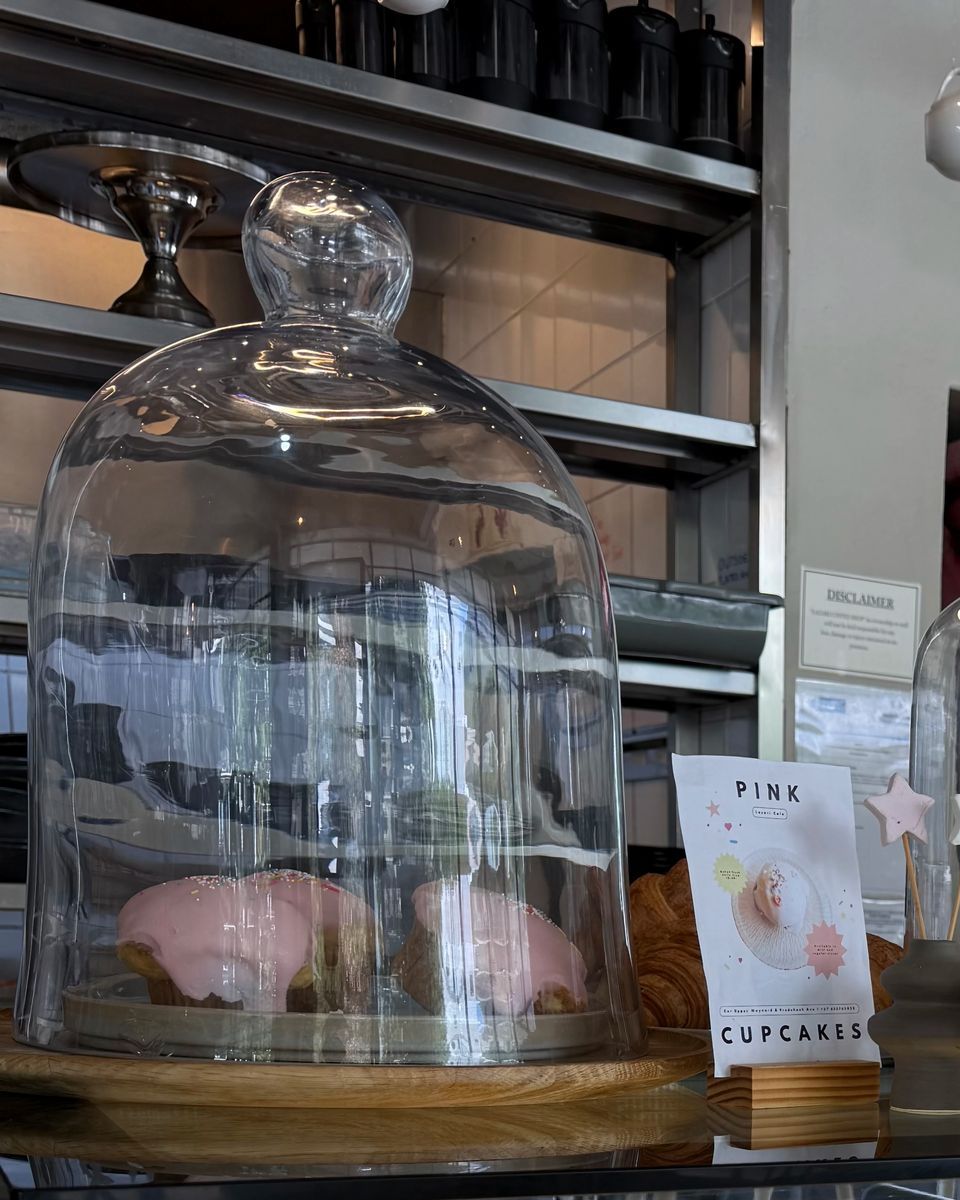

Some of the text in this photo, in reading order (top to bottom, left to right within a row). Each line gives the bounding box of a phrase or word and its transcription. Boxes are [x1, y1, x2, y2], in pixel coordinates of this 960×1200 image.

[826, 589, 895, 610] DISCLAIMER
[736, 780, 800, 803] PINK
[721, 1022, 862, 1044] CUPCAKES
